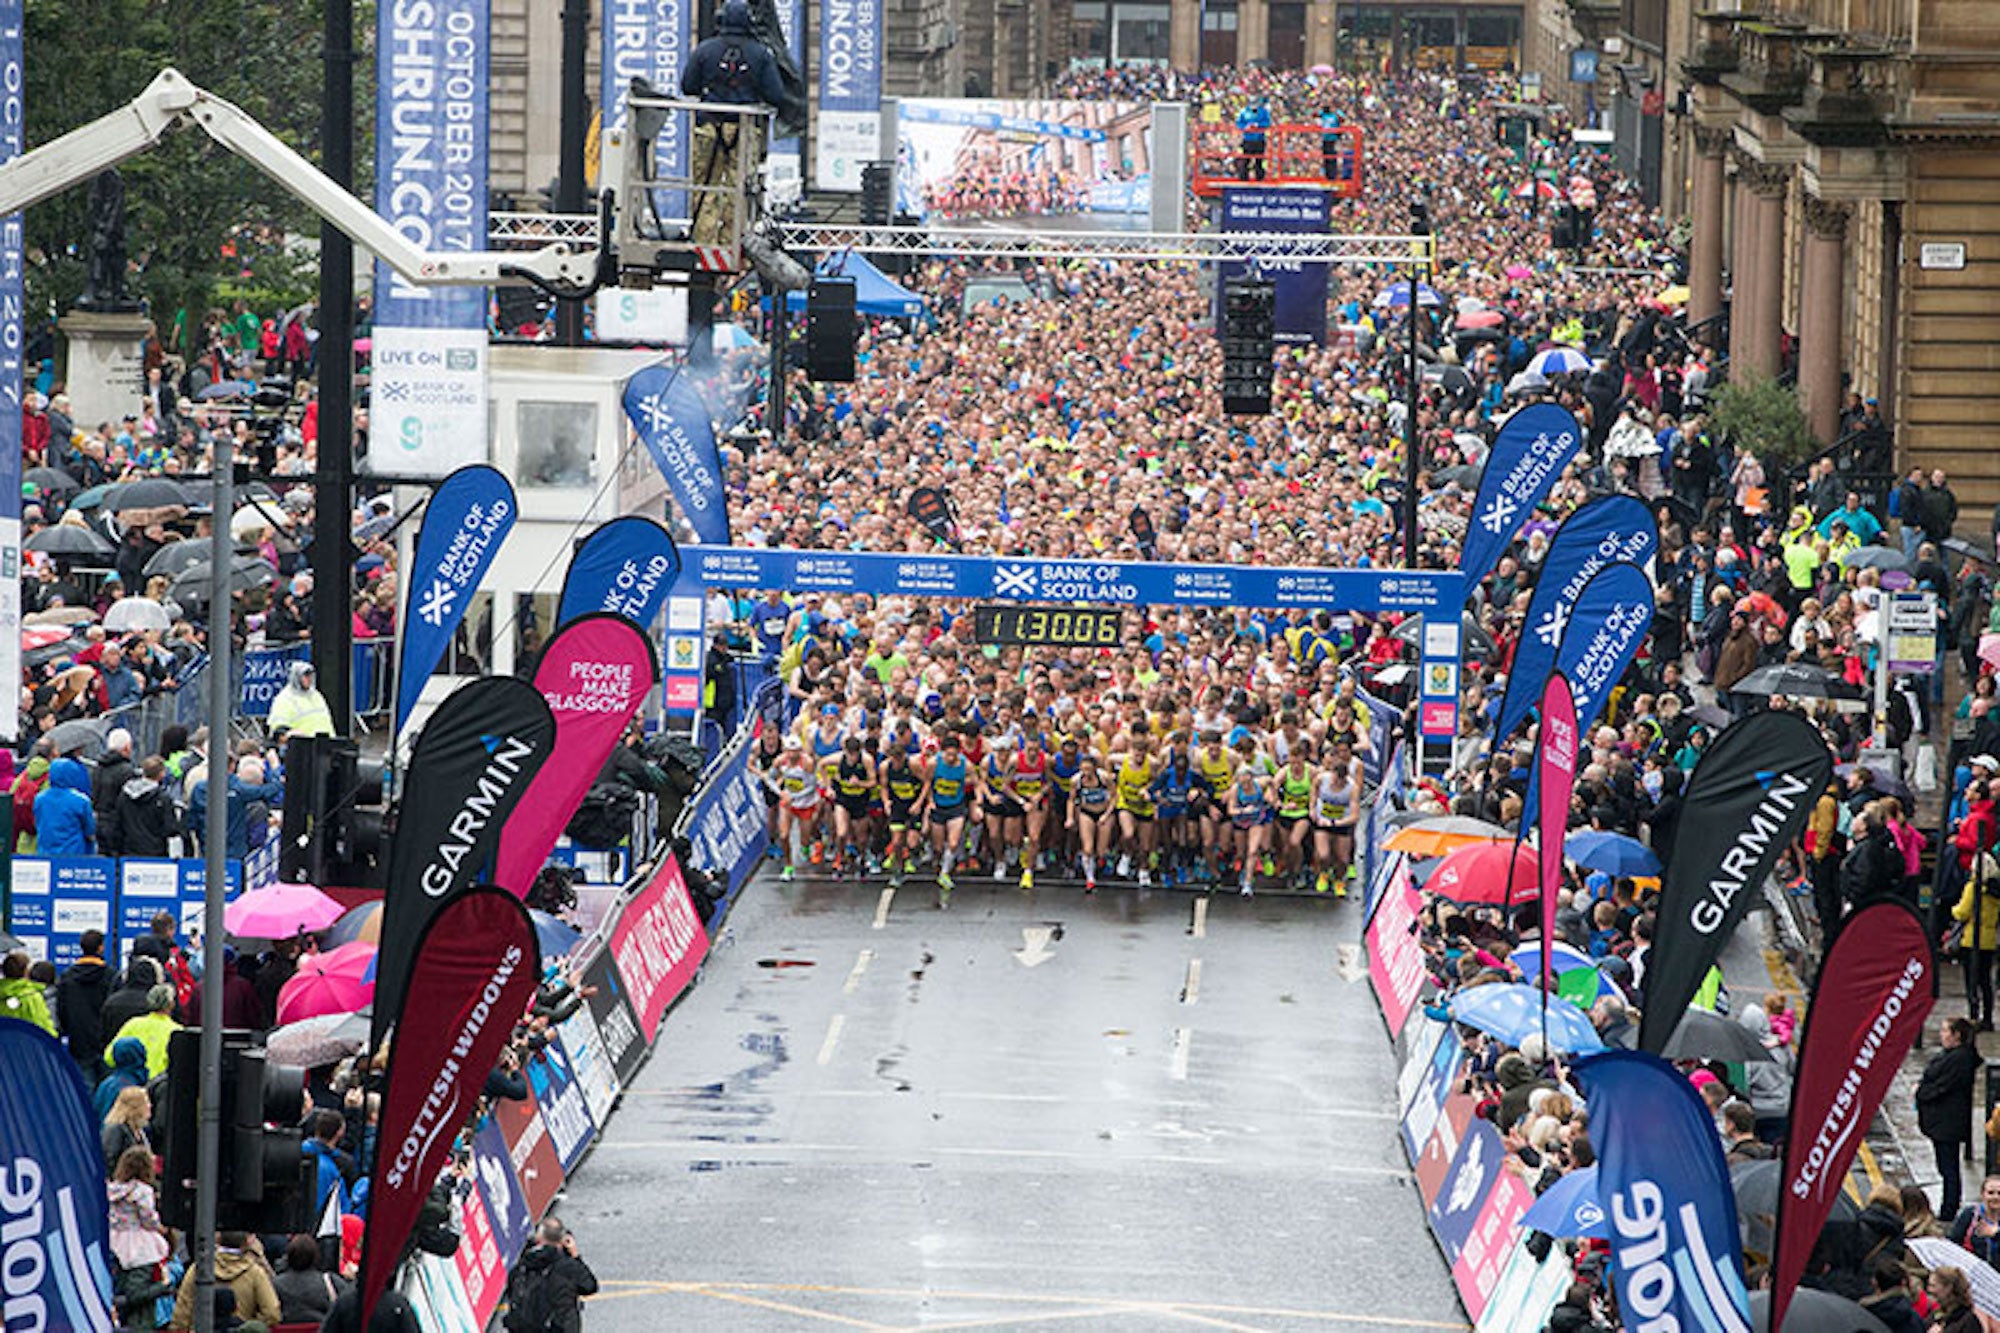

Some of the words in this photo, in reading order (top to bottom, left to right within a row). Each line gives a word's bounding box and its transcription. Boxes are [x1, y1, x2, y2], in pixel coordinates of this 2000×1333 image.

[857, 28, 874, 71] 2017
[445, 11, 475, 163] OCTOBER
[4, 62, 21, 279] OCTER
[444, 174, 474, 250] 2017
[4, 297, 20, 406] 2017
[380, 351, 413, 365] LIVE
[417, 351, 442, 365] ON
[657, 434, 709, 511] SCOTLAND
[670, 426, 700, 468] BANK
[694, 467, 714, 489] OF
[1501, 452, 1536, 494] BANK
[1531, 432, 1553, 456] OF
[1514, 431, 1574, 503] SCOTLAND
[438, 530, 471, 577] BANK
[464, 503, 486, 529] OF
[453, 499, 509, 587] SCOTLAND
[616, 559, 640, 590] OF
[1041, 565, 1093, 582] BANK
[1095, 566, 1122, 582] OF
[1562, 556, 1606, 601] BANK
[1598, 531, 1623, 559] OF
[1041, 583, 1138, 600] SCOTLAND
[570, 662, 633, 681] PEOPLE
[1575, 634, 1609, 678] BANK
[1605, 603, 1629, 631] OF
[1588, 603, 1650, 694] SCOTLAND
[544, 692, 629, 712] GLASGOW
[582, 680, 631, 697] MAKE
[421, 736, 534, 897] GARMIN
[1690, 773, 1806, 934] GARMIN
[387, 1056, 460, 1189] SCOTTISH
[452, 944, 522, 1059] WIDOWS
[1792, 1066, 1864, 1199] SCOTTISH
[1853, 956, 1925, 1069] WIDOWS
